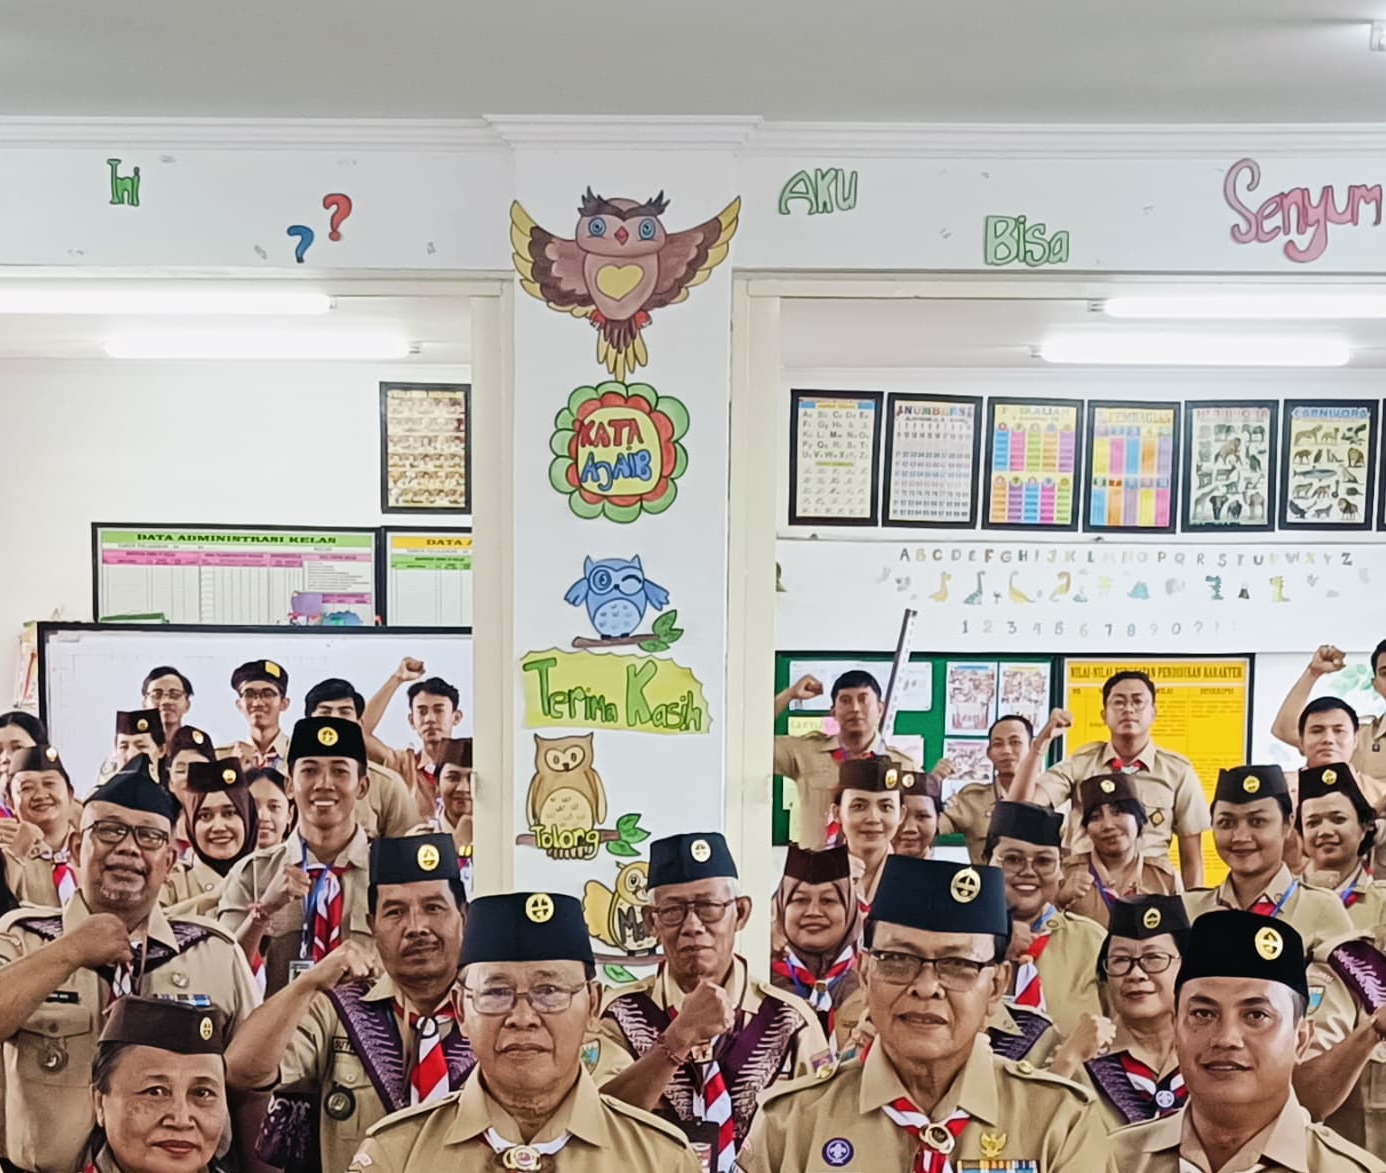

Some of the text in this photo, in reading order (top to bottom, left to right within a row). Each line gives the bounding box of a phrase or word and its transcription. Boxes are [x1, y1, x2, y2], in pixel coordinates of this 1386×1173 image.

[573, 418, 644, 448] KATA
[137, 533, 337, 544] DATA ADMINISTRASI KELAS
[1203, 666, 1242, 678] KARAKTER
[522, 657, 702, 731] Terima Kasih
[529, 825, 601, 859] Tolong
